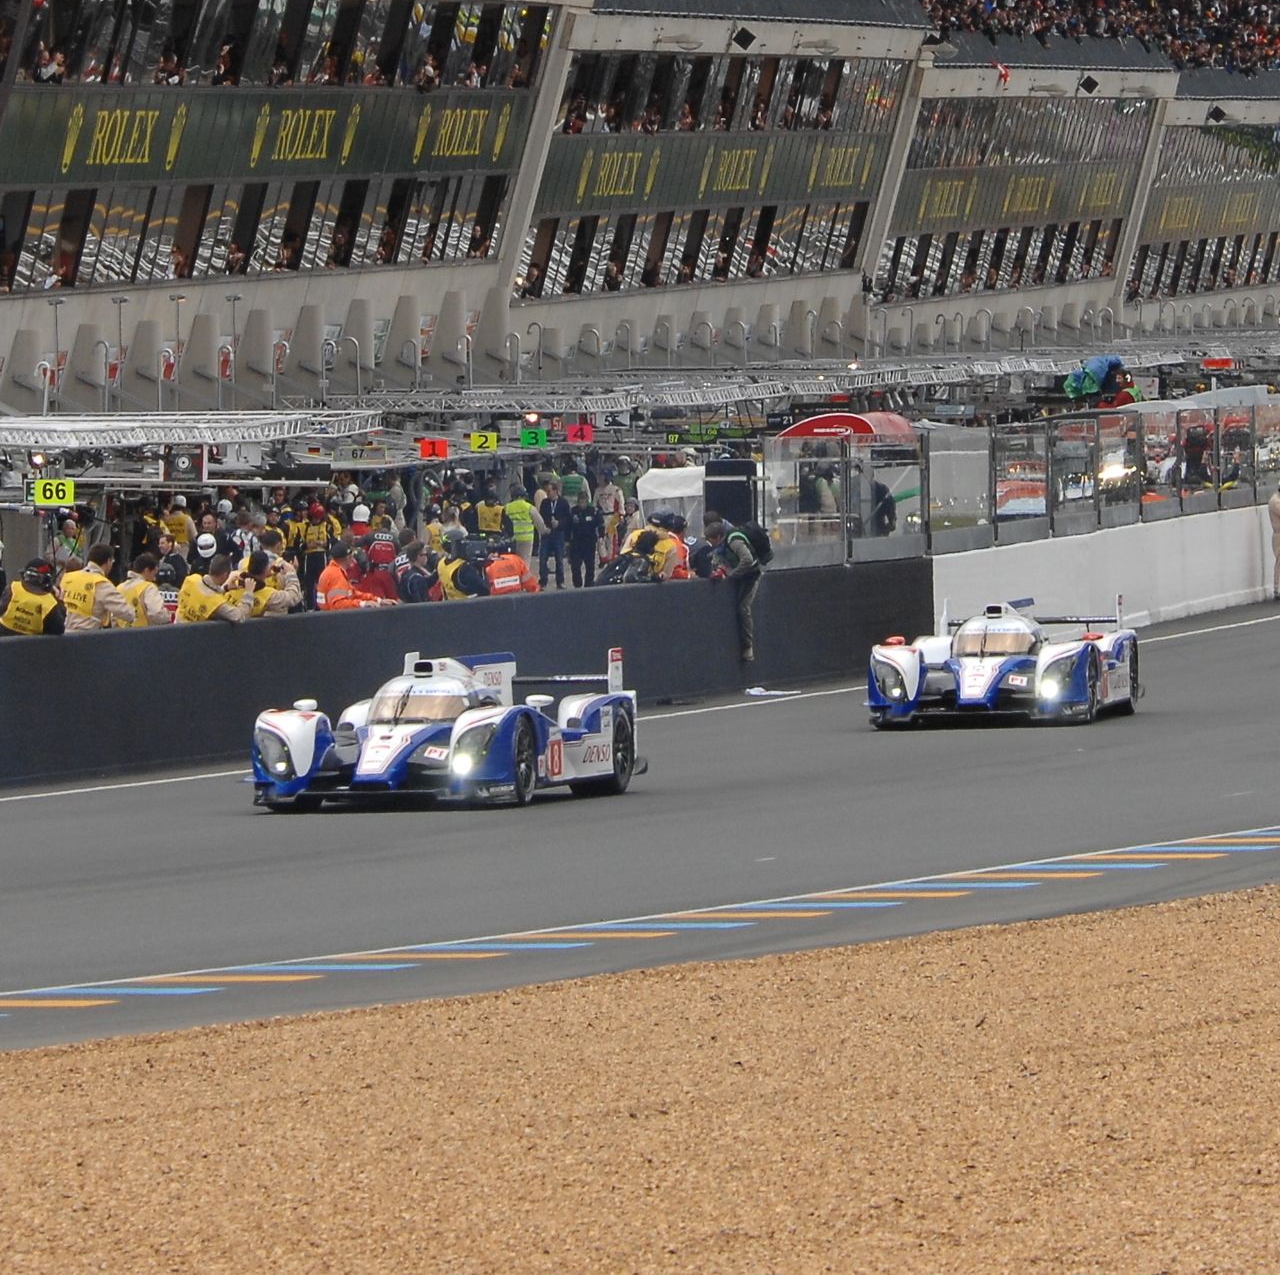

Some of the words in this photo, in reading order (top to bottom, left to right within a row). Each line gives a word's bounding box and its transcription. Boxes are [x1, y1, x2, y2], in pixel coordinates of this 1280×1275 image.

[86, 108, 160, 166] ROLEX
[271, 109, 336, 162] ROLEX
[432, 108, 488, 157] ROLEX
[593, 152, 642, 197] ROLEX
[713, 149, 757, 192] ROLEX
[782, 416, 793, 424] 21
[477, 434, 495, 449] 2
[528, 431, 539, 446] 3
[572, 427, 586, 441] 4
[351, 449, 364, 459] 67
[428, 441, 438, 457] 1
[42, 482, 66, 500] 66
[73, 591, 87, 603] LIVE
[483, 670, 502, 686] DENSO
[1011, 677, 1025, 685] P1
[427, 747, 446, 758] P1
[551, 744, 560, 775] 8
[582, 744, 611, 763] DENSO
